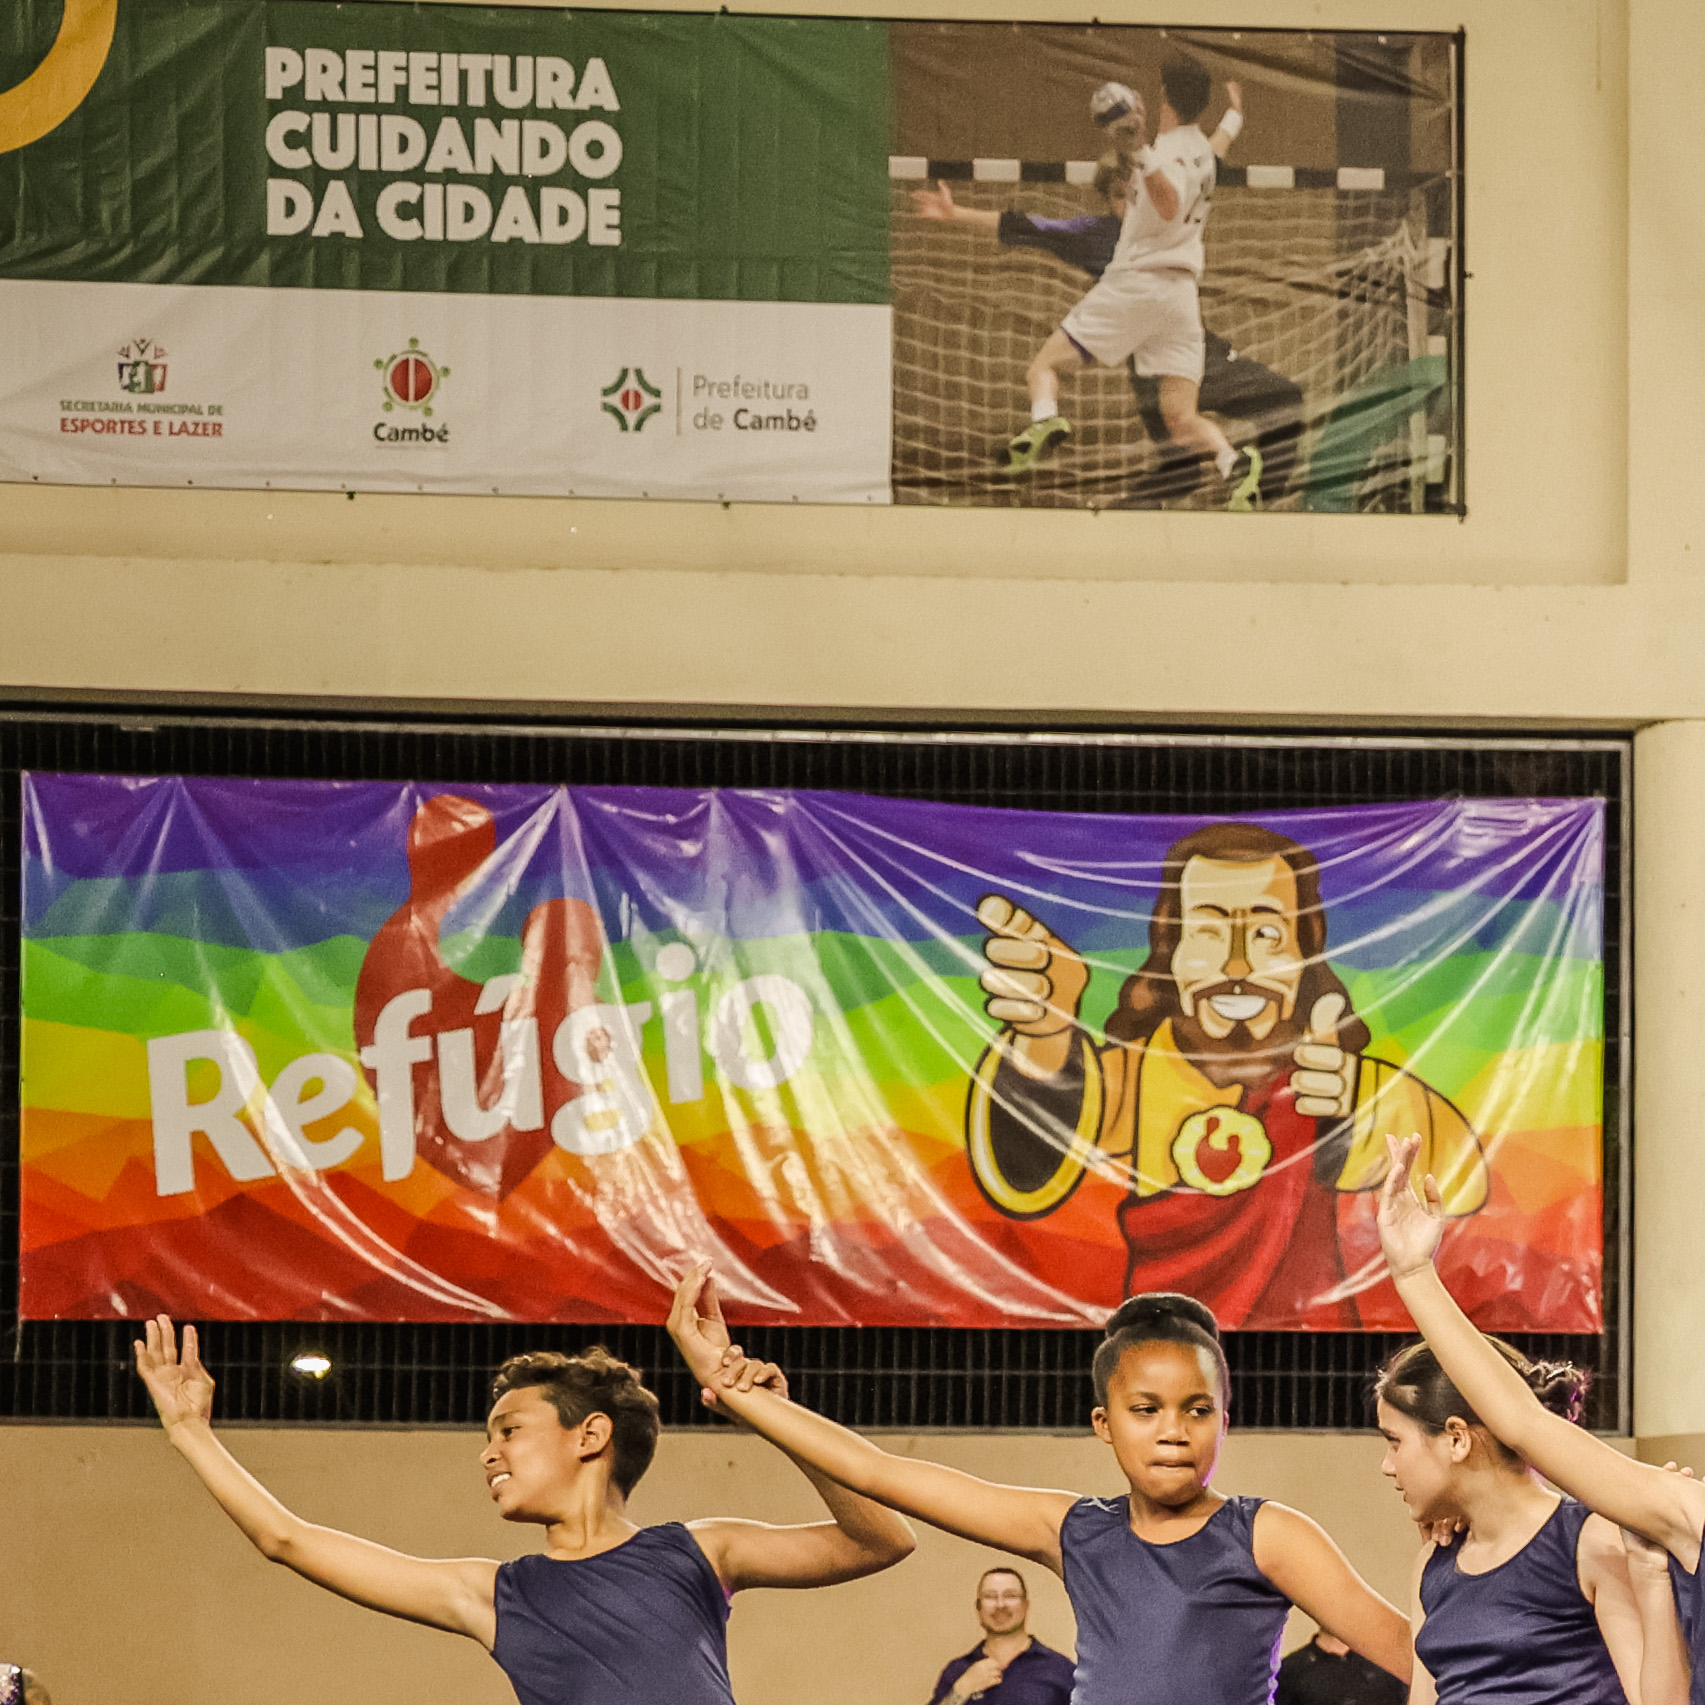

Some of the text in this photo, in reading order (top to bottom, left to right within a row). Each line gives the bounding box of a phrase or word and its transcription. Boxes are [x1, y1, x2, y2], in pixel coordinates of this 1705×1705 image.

[265, 46, 621, 111] PREFEITURA
[265, 110, 623, 179] CUIDANDO
[266, 177, 622, 246] DA CIDADE
[693, 374, 809, 400] Prefeitura
[136, 402, 204, 416] MUNICIPAL
[207, 404, 223, 417] DE
[693, 406, 817, 432] de Cambé
[60, 417, 223, 438] ESPORTES E LAZER
[373, 421, 450, 443] Cambé
[147, 943, 814, 1197] Refúgio
